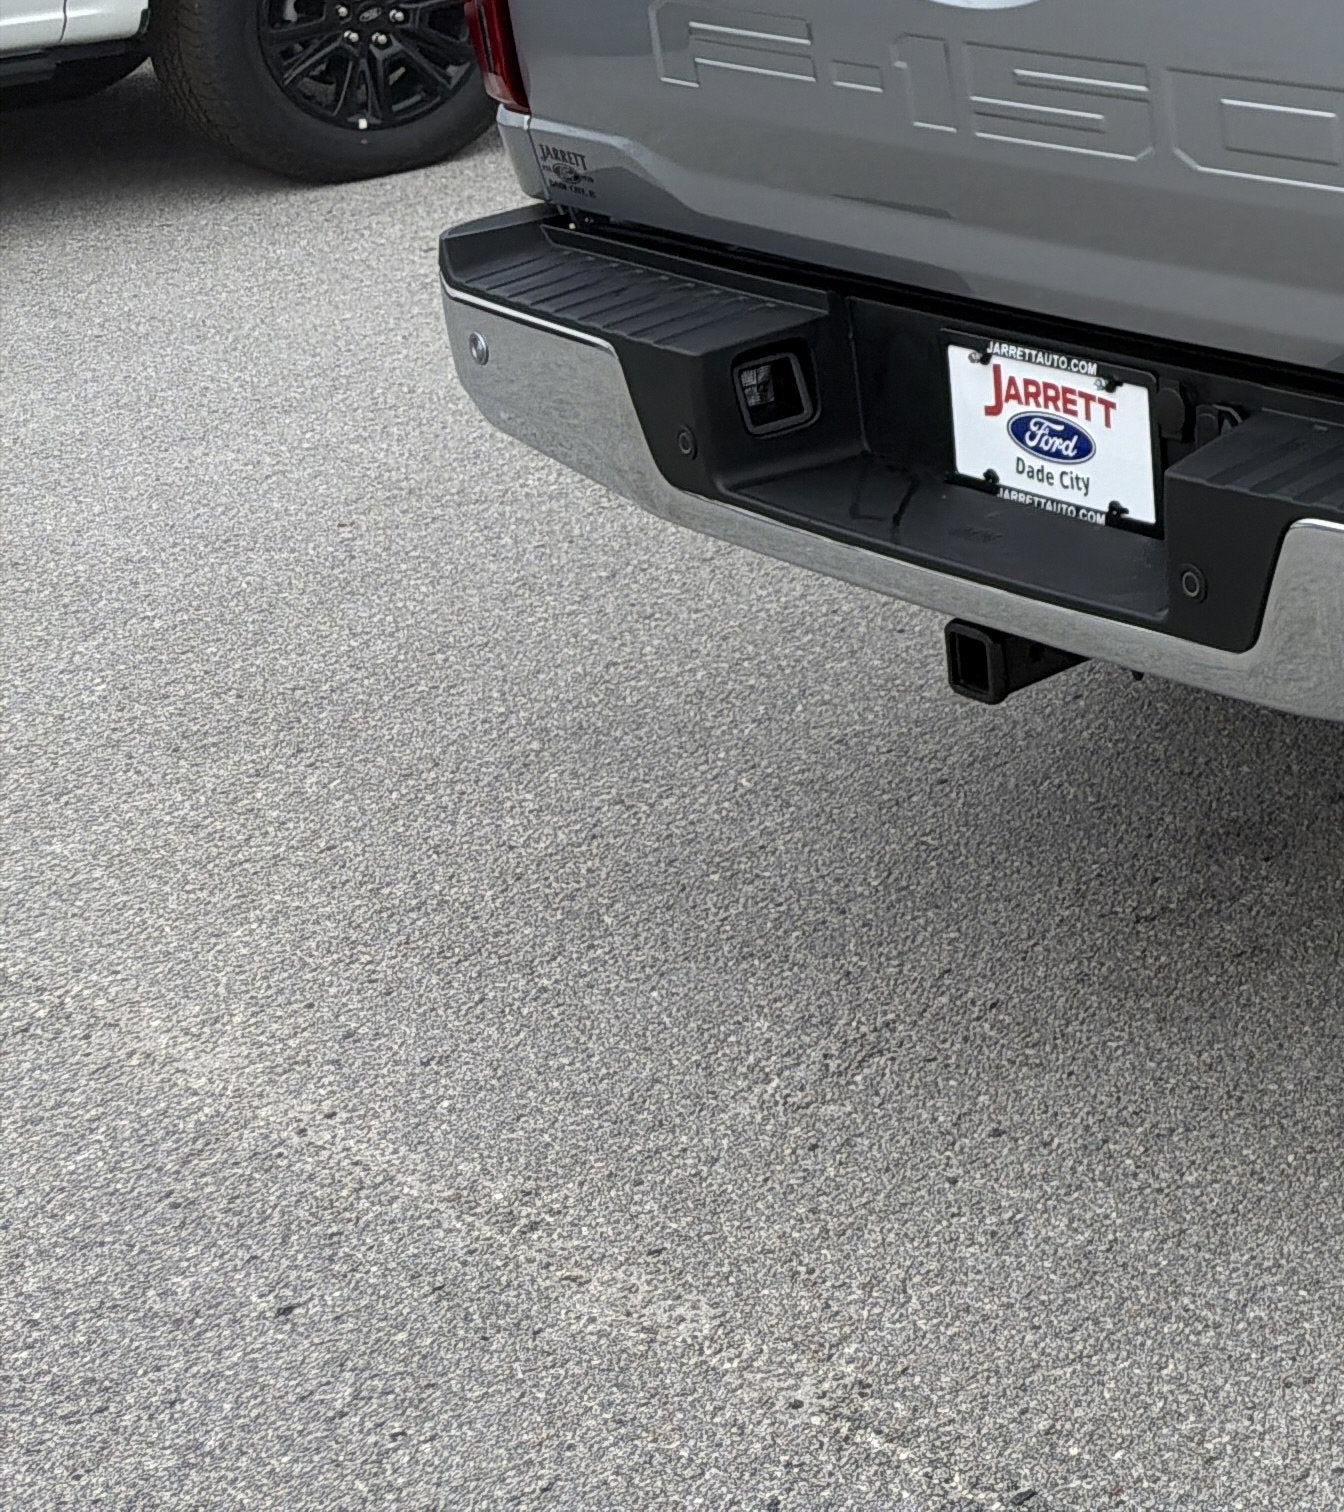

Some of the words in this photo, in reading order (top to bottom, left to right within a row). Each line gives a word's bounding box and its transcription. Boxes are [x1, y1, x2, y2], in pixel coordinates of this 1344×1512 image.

[539, 143, 588, 170] JARRETT
[986, 340, 1098, 376] JARRETTAUTO.COM
[984, 363, 1117, 429] JARRETT
[1024, 417, 1079, 458] Ford
[1015, 456, 1055, 487] Dade
[1059, 471, 1091, 497] City
